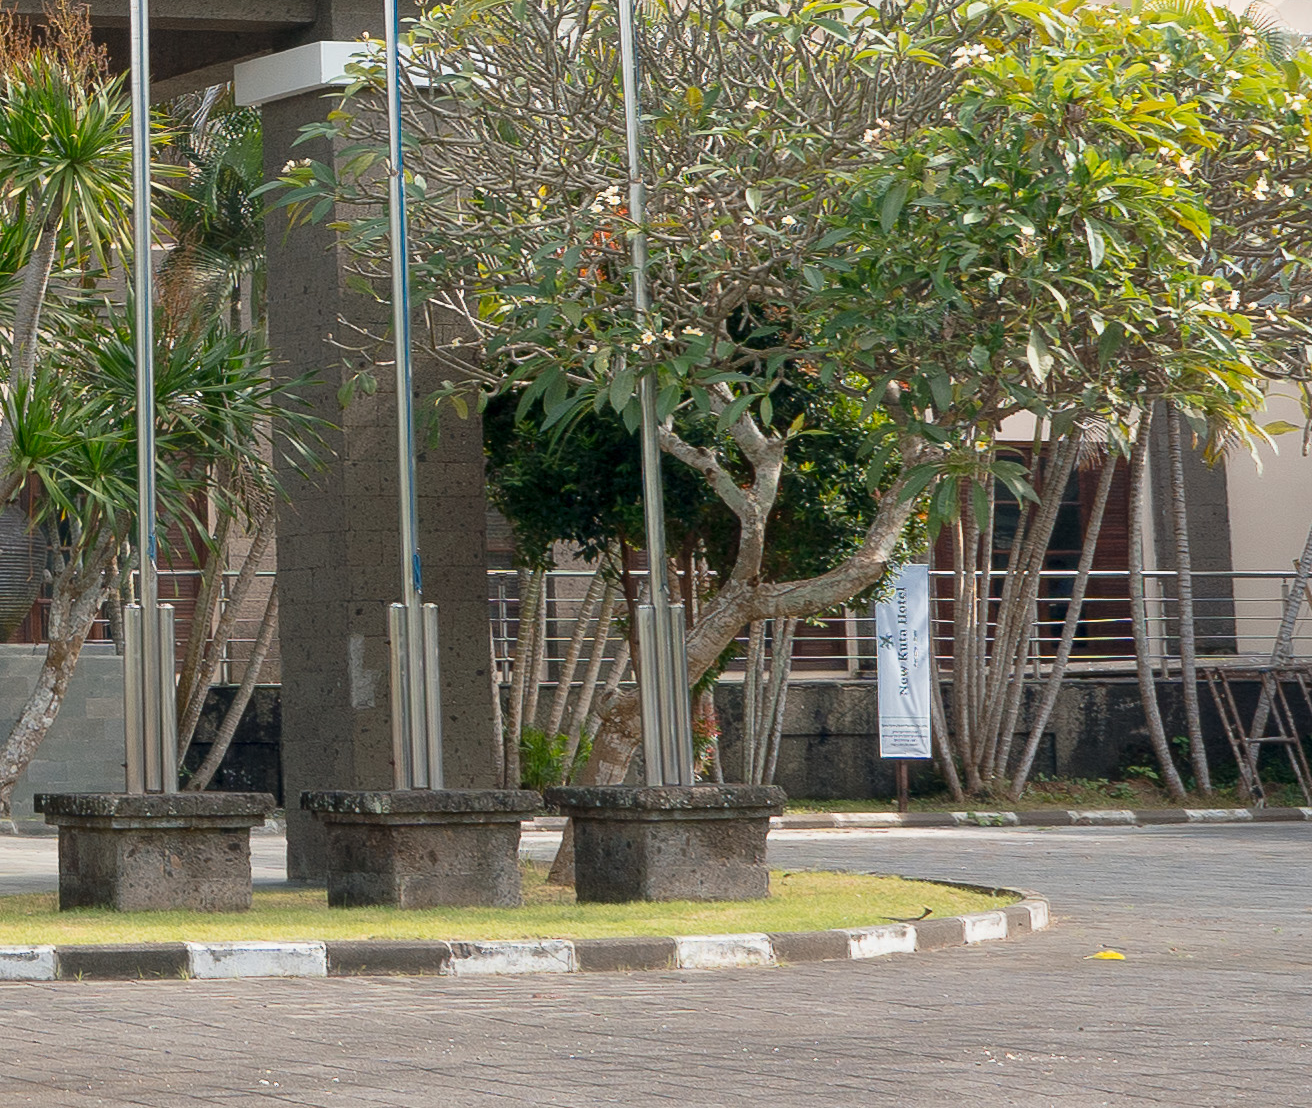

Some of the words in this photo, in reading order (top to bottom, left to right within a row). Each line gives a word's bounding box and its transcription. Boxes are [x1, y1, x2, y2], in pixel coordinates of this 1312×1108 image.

[896, 586, 907, 625] Hotel
[897, 629, 908, 661] Kuta
[899, 666, 909, 696] New
